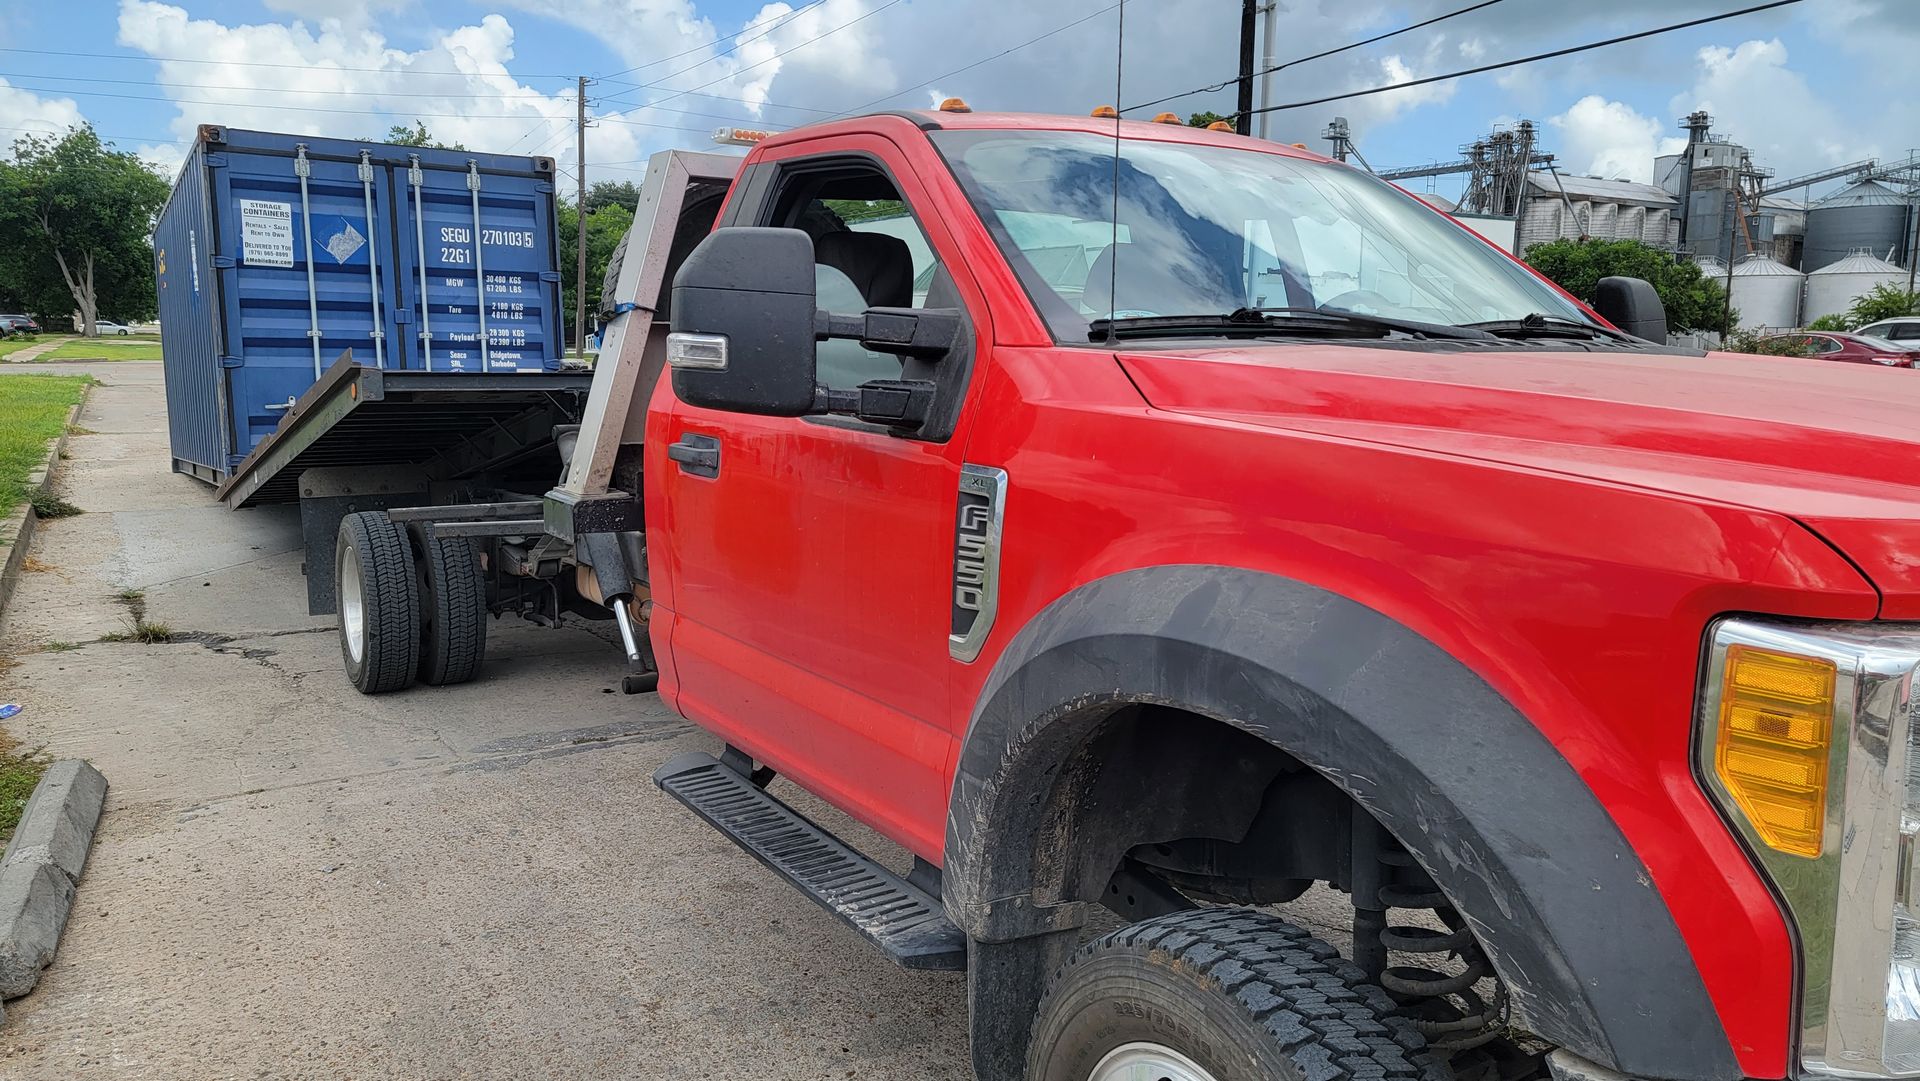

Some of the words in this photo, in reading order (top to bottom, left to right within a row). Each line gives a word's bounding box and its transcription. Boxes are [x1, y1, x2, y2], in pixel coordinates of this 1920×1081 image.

[243, 208, 290, 218] CONTAINERS
[441, 227, 470, 243] SEGU
[441, 247, 470, 263] 22G1
[446, 278, 464, 287] MGW
[509, 276, 522, 284] KGS
[449, 305, 462, 314] Tare
[511, 303, 524, 311] KGS
[450, 333, 475, 342] Payload
[972, 478, 984, 487] XL
[955, 504, 988, 612] F550
